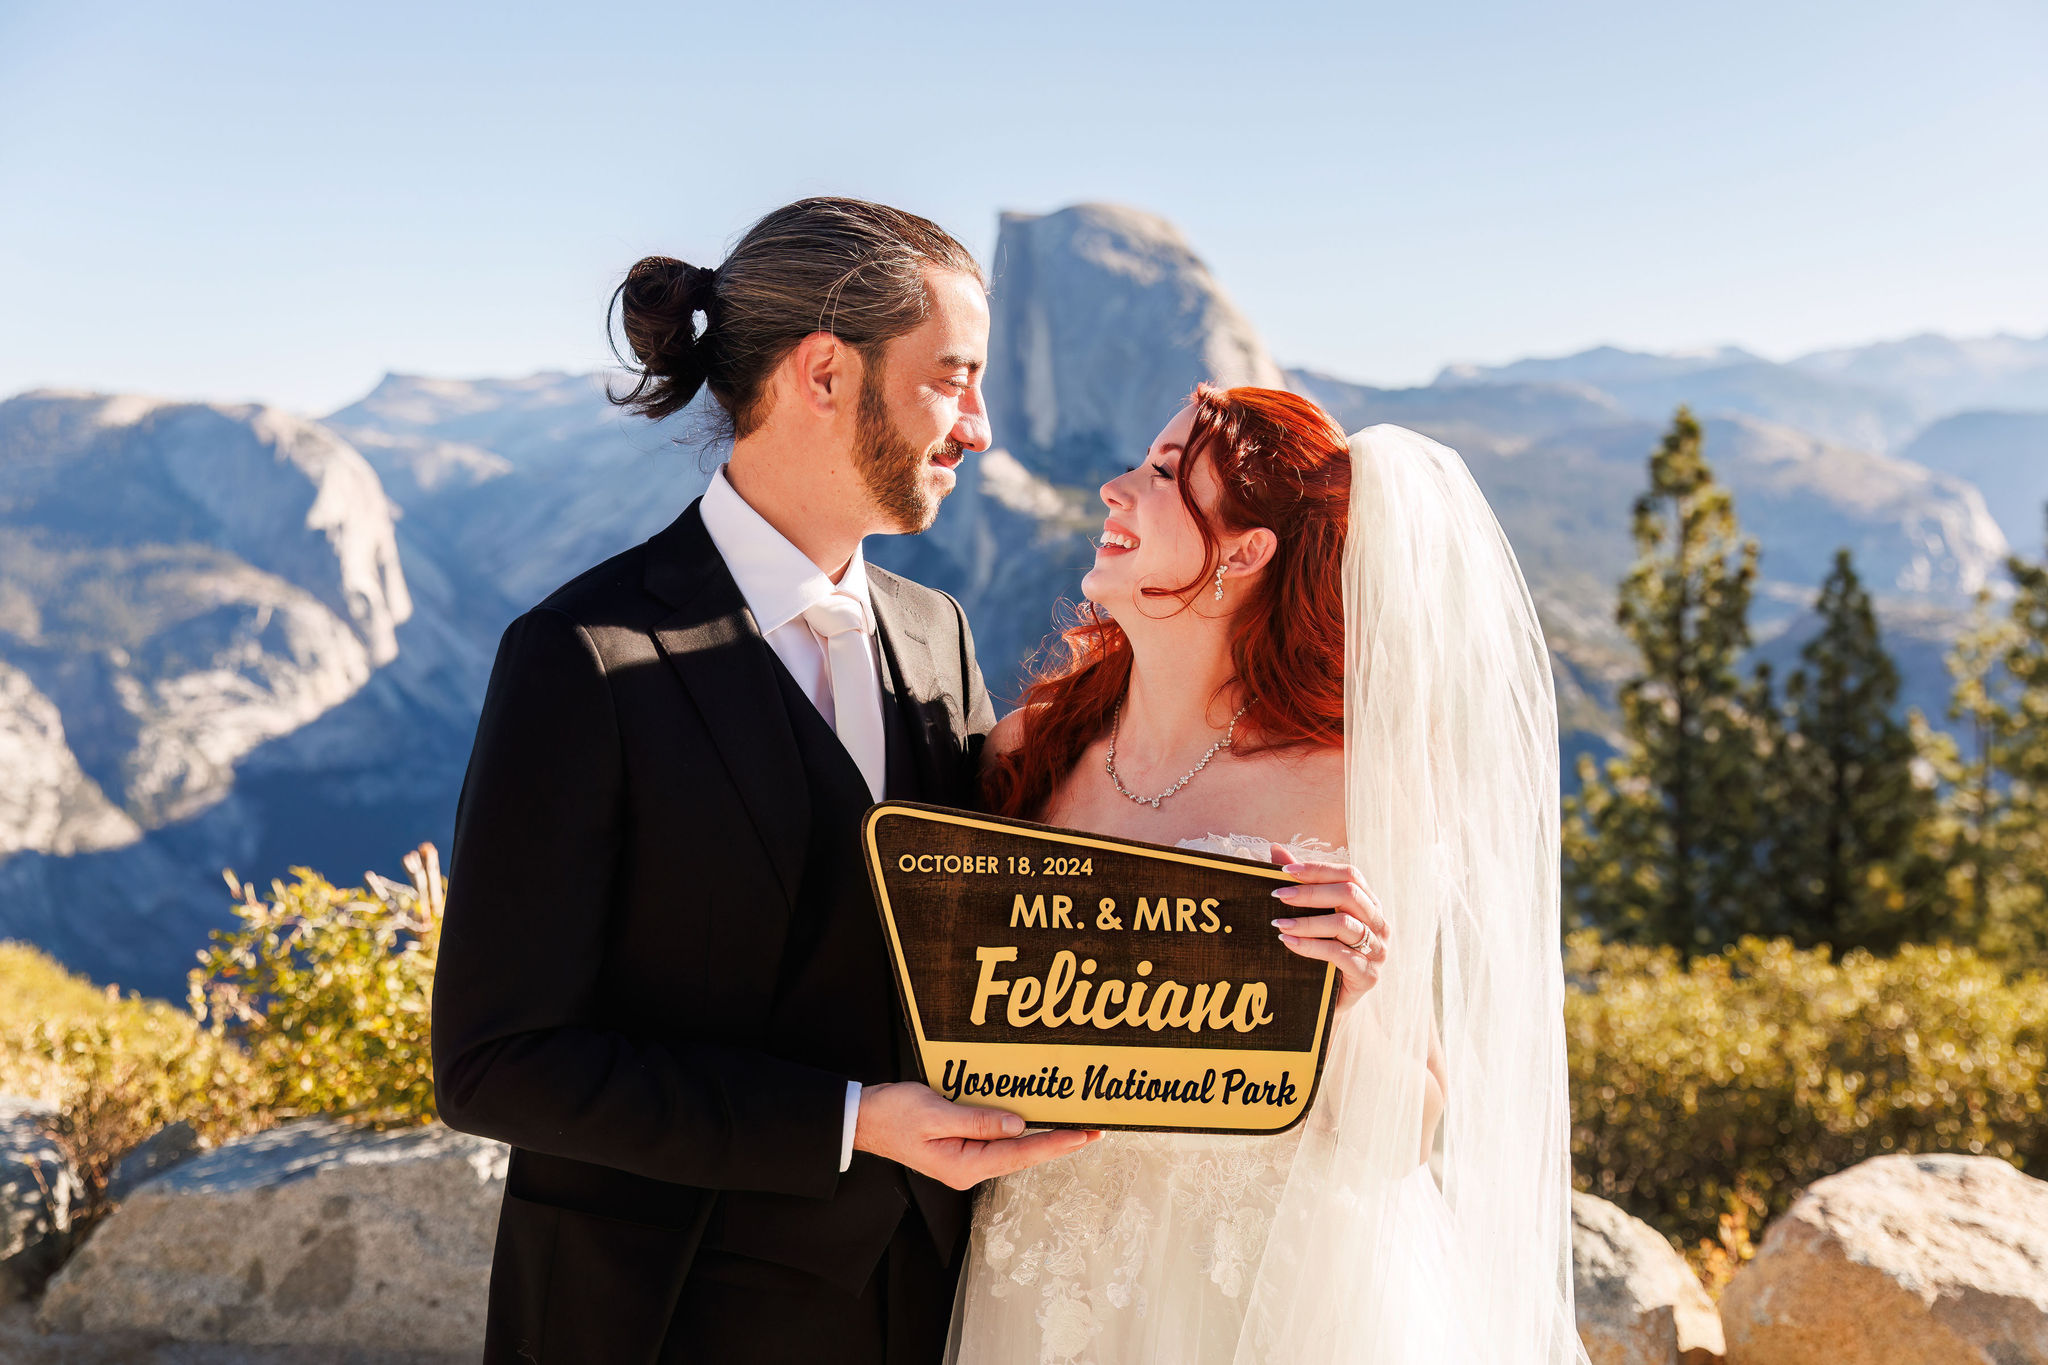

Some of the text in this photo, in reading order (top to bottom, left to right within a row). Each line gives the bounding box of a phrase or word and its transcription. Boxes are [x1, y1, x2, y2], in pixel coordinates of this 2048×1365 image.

[898, 854, 1094, 877] OCTOBER 18, 2024
[1009, 894, 1233, 934] MR. & MRS.
[969, 945, 1274, 1033] Feliciano
[941, 1060, 1298, 1108] Yosemite National Park
